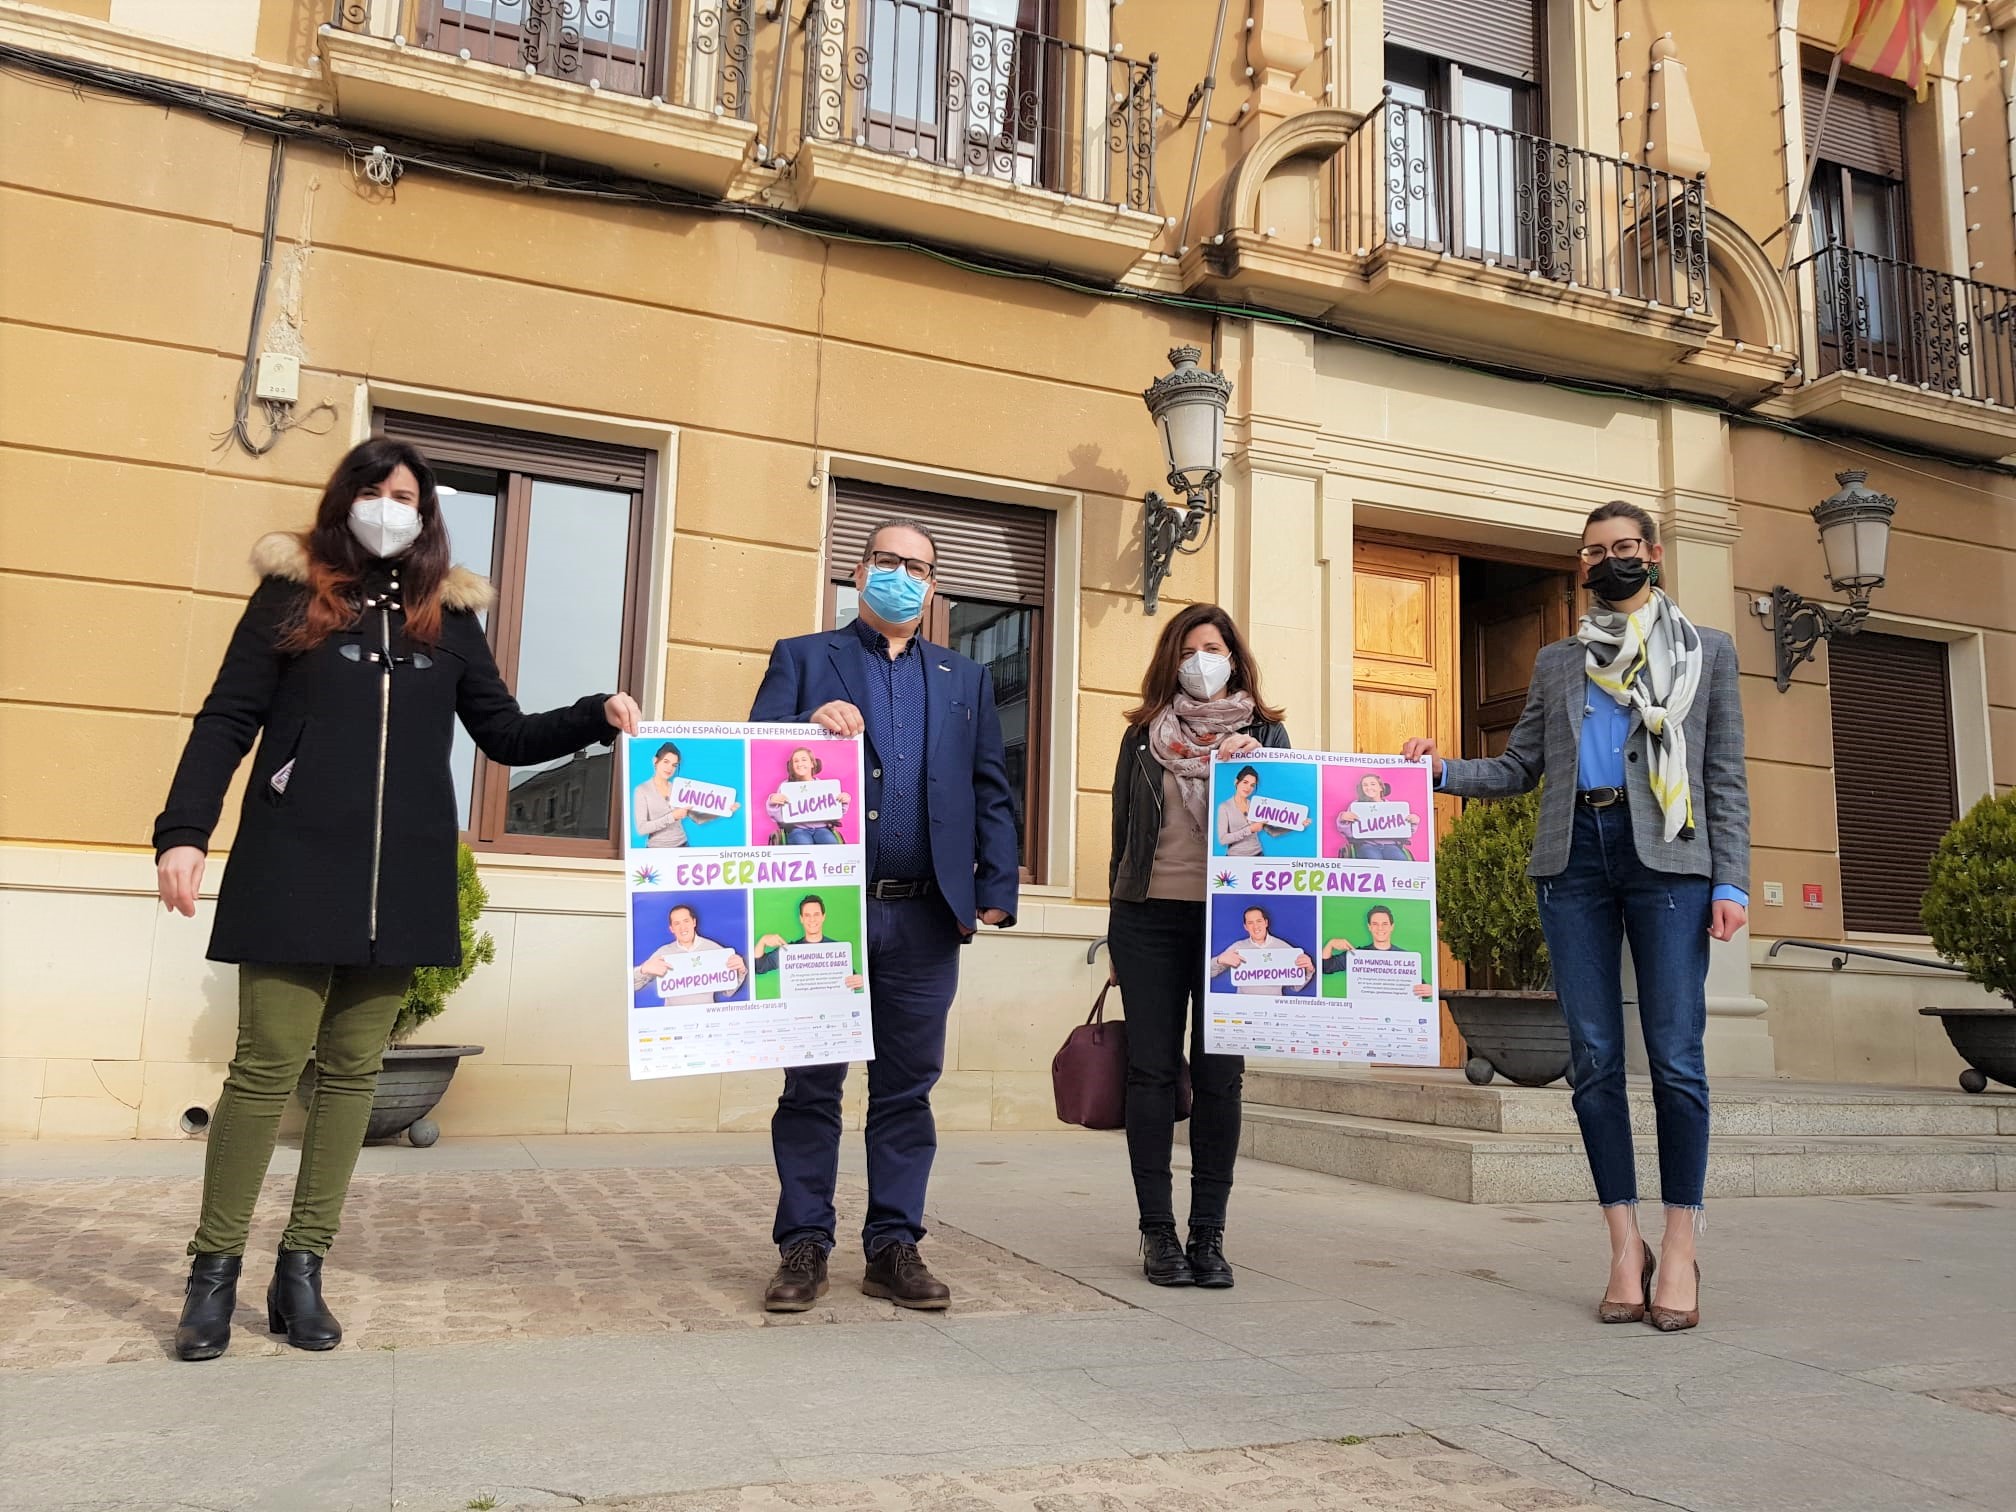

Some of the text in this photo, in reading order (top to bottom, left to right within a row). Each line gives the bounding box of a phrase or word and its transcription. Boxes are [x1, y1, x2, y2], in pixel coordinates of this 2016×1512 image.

[639, 724, 691, 734] DERACIÓN
[692, 725, 742, 735] ESPAÑOLA
[757, 727, 828, 736] ENFERMEDADES
[1268, 751, 1314, 761] ESPAÑOLA
[1328, 755, 1397, 764] ENFERMEDADES
[678, 788, 727, 811] UNIÓN
[788, 793, 837, 817] LUCHA
[1255, 805, 1300, 826] UNIÓN
[1358, 813, 1406, 833] LUCHA
[719, 851, 760, 859] SÍNTOMAS
[823, 862, 857, 874] feder
[1291, 860, 1330, 869] SÍNTOMAS
[676, 860, 818, 886] ESPERANZA
[1251, 870, 1387, 892] ESPERANZA
[1392, 876, 1426, 889] feder
[797, 952, 824, 961] MUNDIAL
[834, 951, 847, 959] LAS
[785, 961, 830, 970] ENFERMEDADES
[1352, 966, 1397, 975] ENFERMEDADES
[661, 969, 736, 992] COMPROMISO
[1234, 967, 1304, 982] COMPROMISO
[705, 1002, 788, 1014] www.enfermedades-raras.org
[1275, 998, 1353, 1010] www.enfermedades-raras.org
